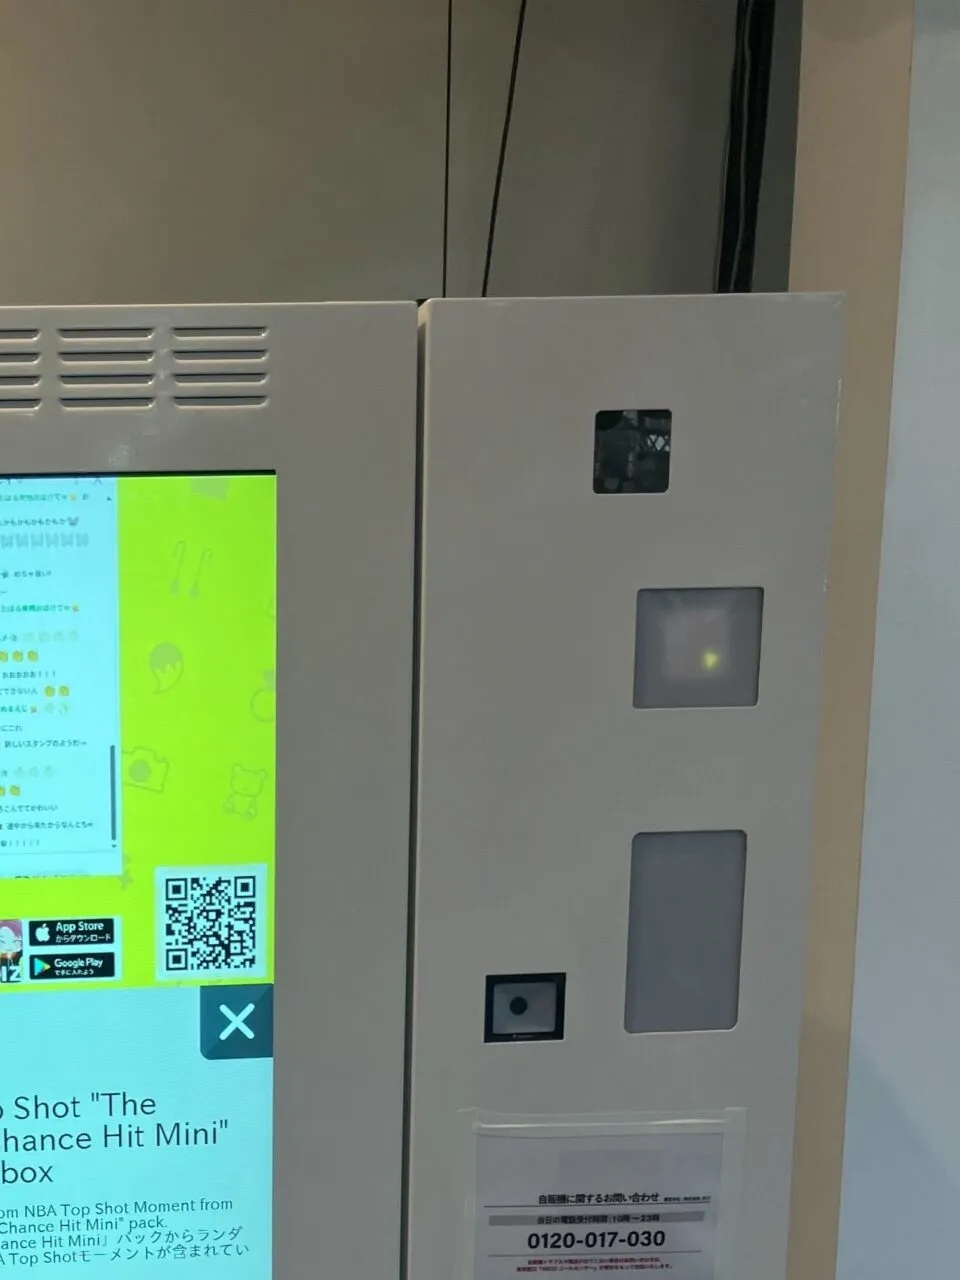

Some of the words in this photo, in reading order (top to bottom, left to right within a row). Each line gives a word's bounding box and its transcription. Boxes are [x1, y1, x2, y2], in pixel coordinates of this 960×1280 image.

[56, 922, 76, 933] App
[78, 921, 105, 931] Store
[56, 933, 111, 943] からダウンロード
[54, 958, 85, 969] Google
[85, 957, 103, 968] Play
[14, 1095, 80, 1120] Shot
[91, 1092, 157, 1116] "The
[103, 1123, 144, 1148] Hit
[155, 1119, 228, 1146] Mini"
[1, 1160, 54, 1184] box
[24, 1205, 57, 1218] NBA
[60, 1203, 90, 1219] Top
[95, 1202, 129, 1216] Shot
[134, 1200, 195, 1214] Moment
[199, 1198, 233, 1212] from
[59, 1219, 81, 1232] Hit
[85, 1217, 124, 1231] Mini"
[128, 1216, 168, 1233] pack.
[41, 1234, 63, 1248] Hit
[67, 1232, 108, 1248] Mini」
[117, 1226, 243, 1245] パックからランダ
[527, 1230, 666, 1249] 0120-017-030
[9, 1252, 39, 1268] Top
